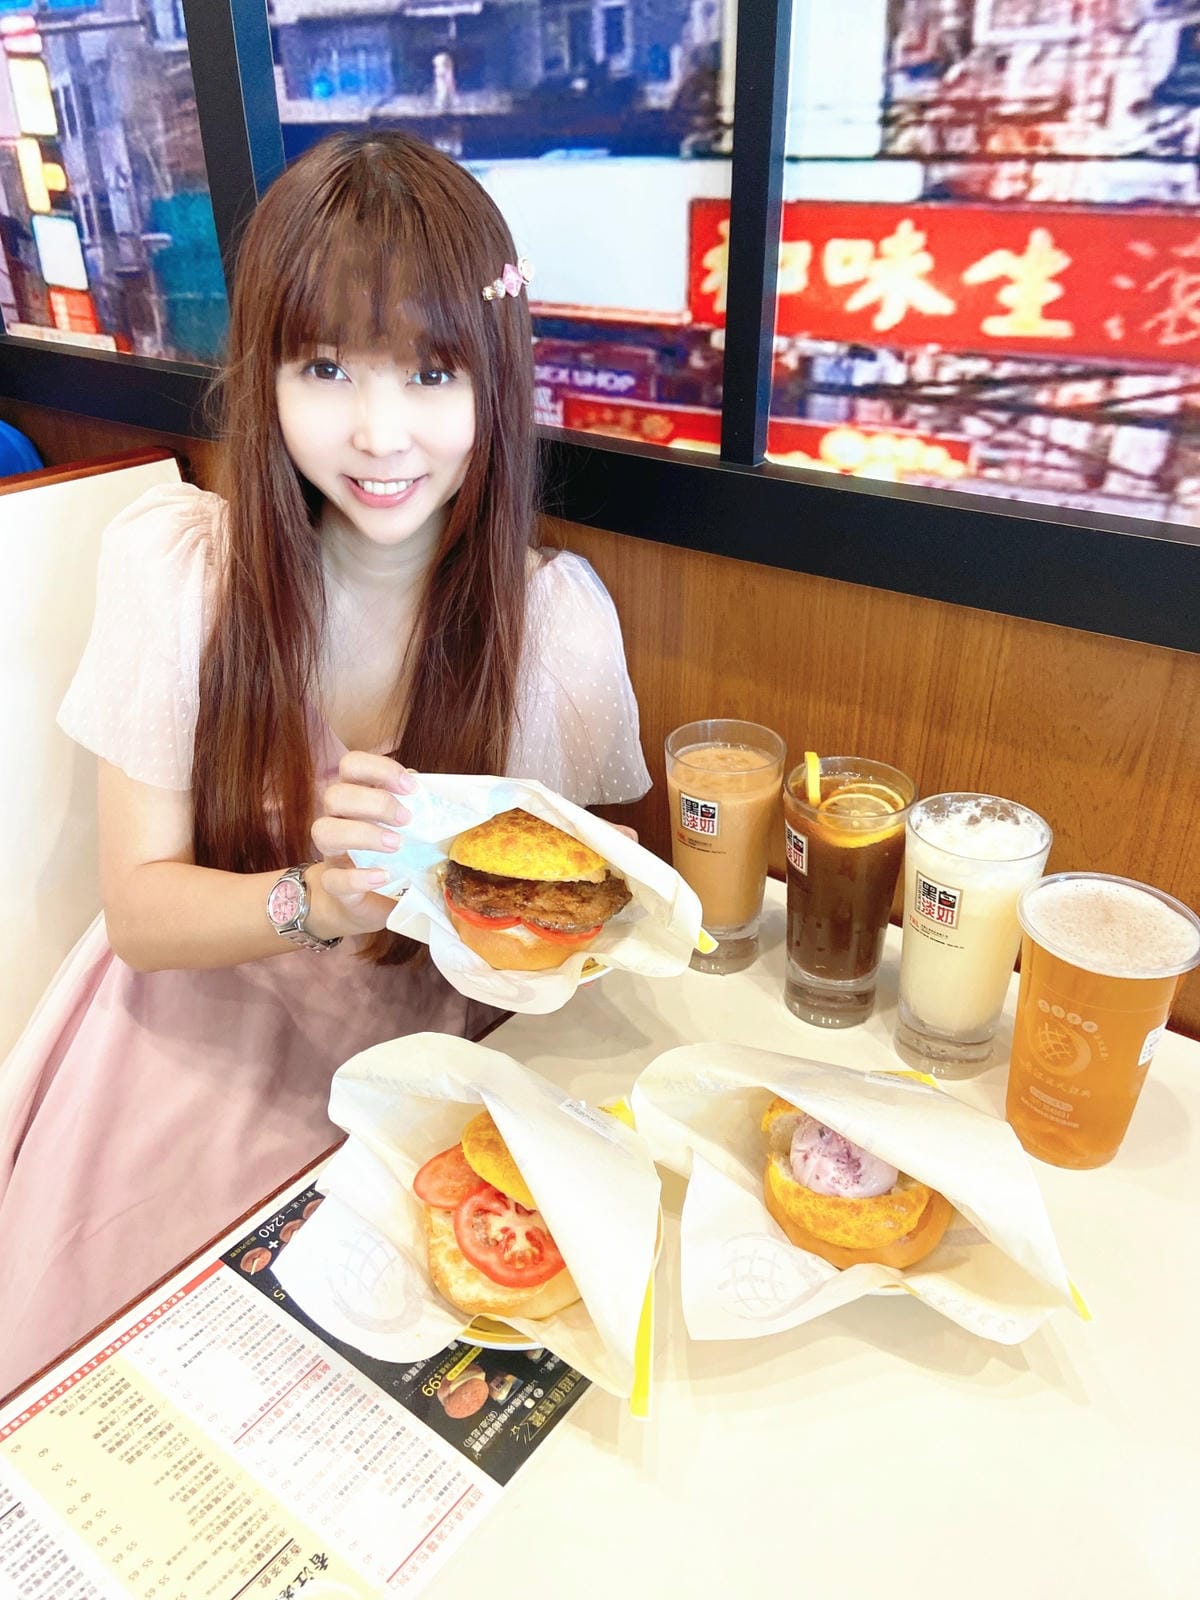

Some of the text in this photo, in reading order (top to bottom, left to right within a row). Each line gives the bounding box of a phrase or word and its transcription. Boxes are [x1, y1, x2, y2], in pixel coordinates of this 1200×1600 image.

[921, 897, 955, 925] 淡奶
[257, 1213, 285, 1239] $240
[420, 1372, 441, 1397] $99
